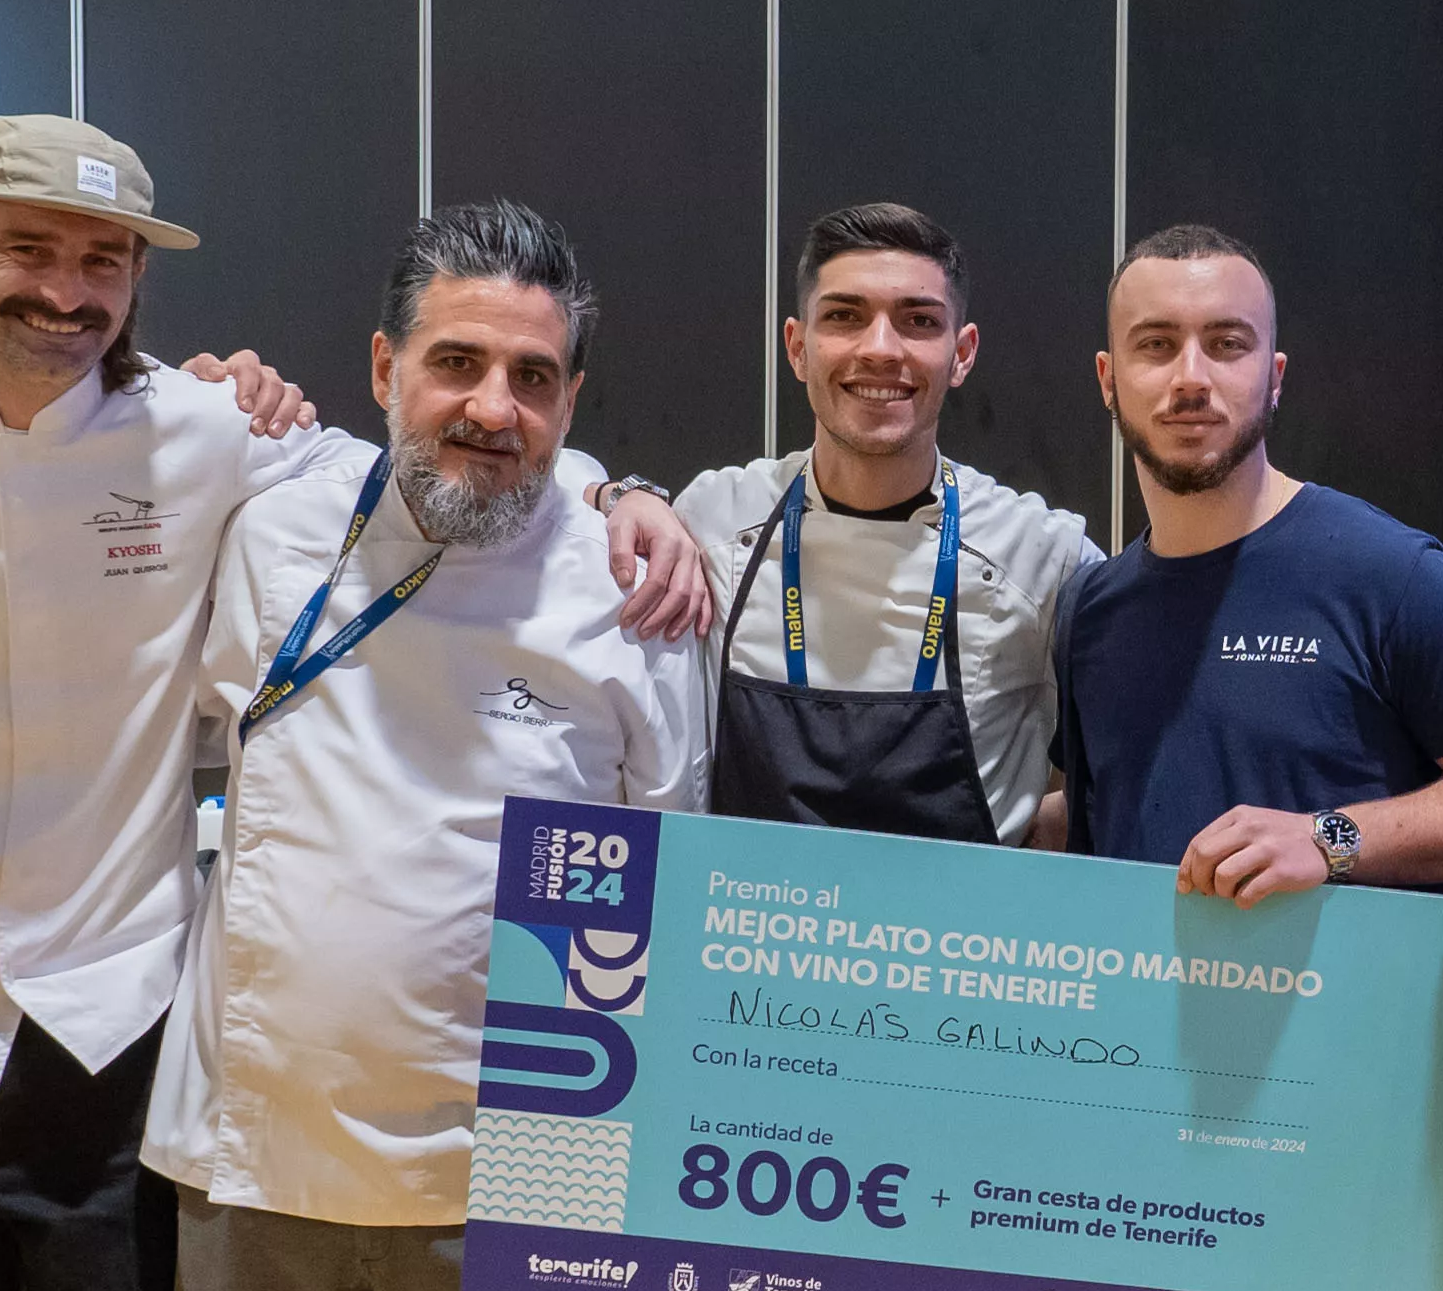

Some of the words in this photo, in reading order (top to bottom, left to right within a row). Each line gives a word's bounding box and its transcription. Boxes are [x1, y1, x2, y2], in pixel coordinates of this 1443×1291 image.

[107, 544, 162, 558] KYOSHI
[104, 568, 129, 578] JUAN
[785, 587, 804, 652] makro
[922, 595, 947, 660] makro
[1222, 636, 1247, 652] LA
[1257, 636, 1319, 654] VIEJA
[1235, 653, 1268, 662] JONAY
[488, 709, 522, 723] SERGIO
[528, 826, 550, 899] MADRID
[546, 828, 567, 900] FUSIÓN
[568, 831, 630, 869] 20
[565, 868, 625, 906] 24
[708, 870, 809, 906] Premio
[815, 884, 840, 909] al
[704, 906, 819, 945] MEJOR
[825, 919, 932, 956] PLATO
[939, 931, 1019, 966] CON
[1024, 940, 1125, 980] MOJO
[1130, 952, 1323, 998] MARIDADO
[701, 943, 781, 977] CON
[788, 951, 879, 987] VINO
[885, 962, 932, 993] DE
[938, 967, 1098, 1011] TENERIFE
[692, 1043, 737, 1068] Con
[743, 1047, 762, 1069] la
[767, 1054, 838, 1077] receta
[689, 1114, 711, 1133] La
[715, 1121, 803, 1143] cantidad
[806, 1127, 834, 1146] de
[1177, 1128, 1194, 1142] 31
[1196, 1131, 1213, 1144] de
[1214, 1134, 1250, 1148] enero
[1252, 1136, 1269, 1150] de
[1270, 1138, 1307, 1153] 2024
[678, 1143, 910, 1229] 800€
[973, 1179, 1032, 1204] Gran
[1037, 1189, 1101, 1211] cesta
[1105, 1193, 1138, 1215] de
[1141, 1200, 1266, 1228] productos
[970, 1208, 1080, 1236] premium
[1084, 1217, 1117, 1239] de
[1122, 1221, 1218, 1249] Tenerife
[529, 1272, 572, 1284] despierta
[574, 1278, 623, 1289] emociones
[766, 1273, 803, 1289] Vinos
[805, 1276, 822, 1291] de
